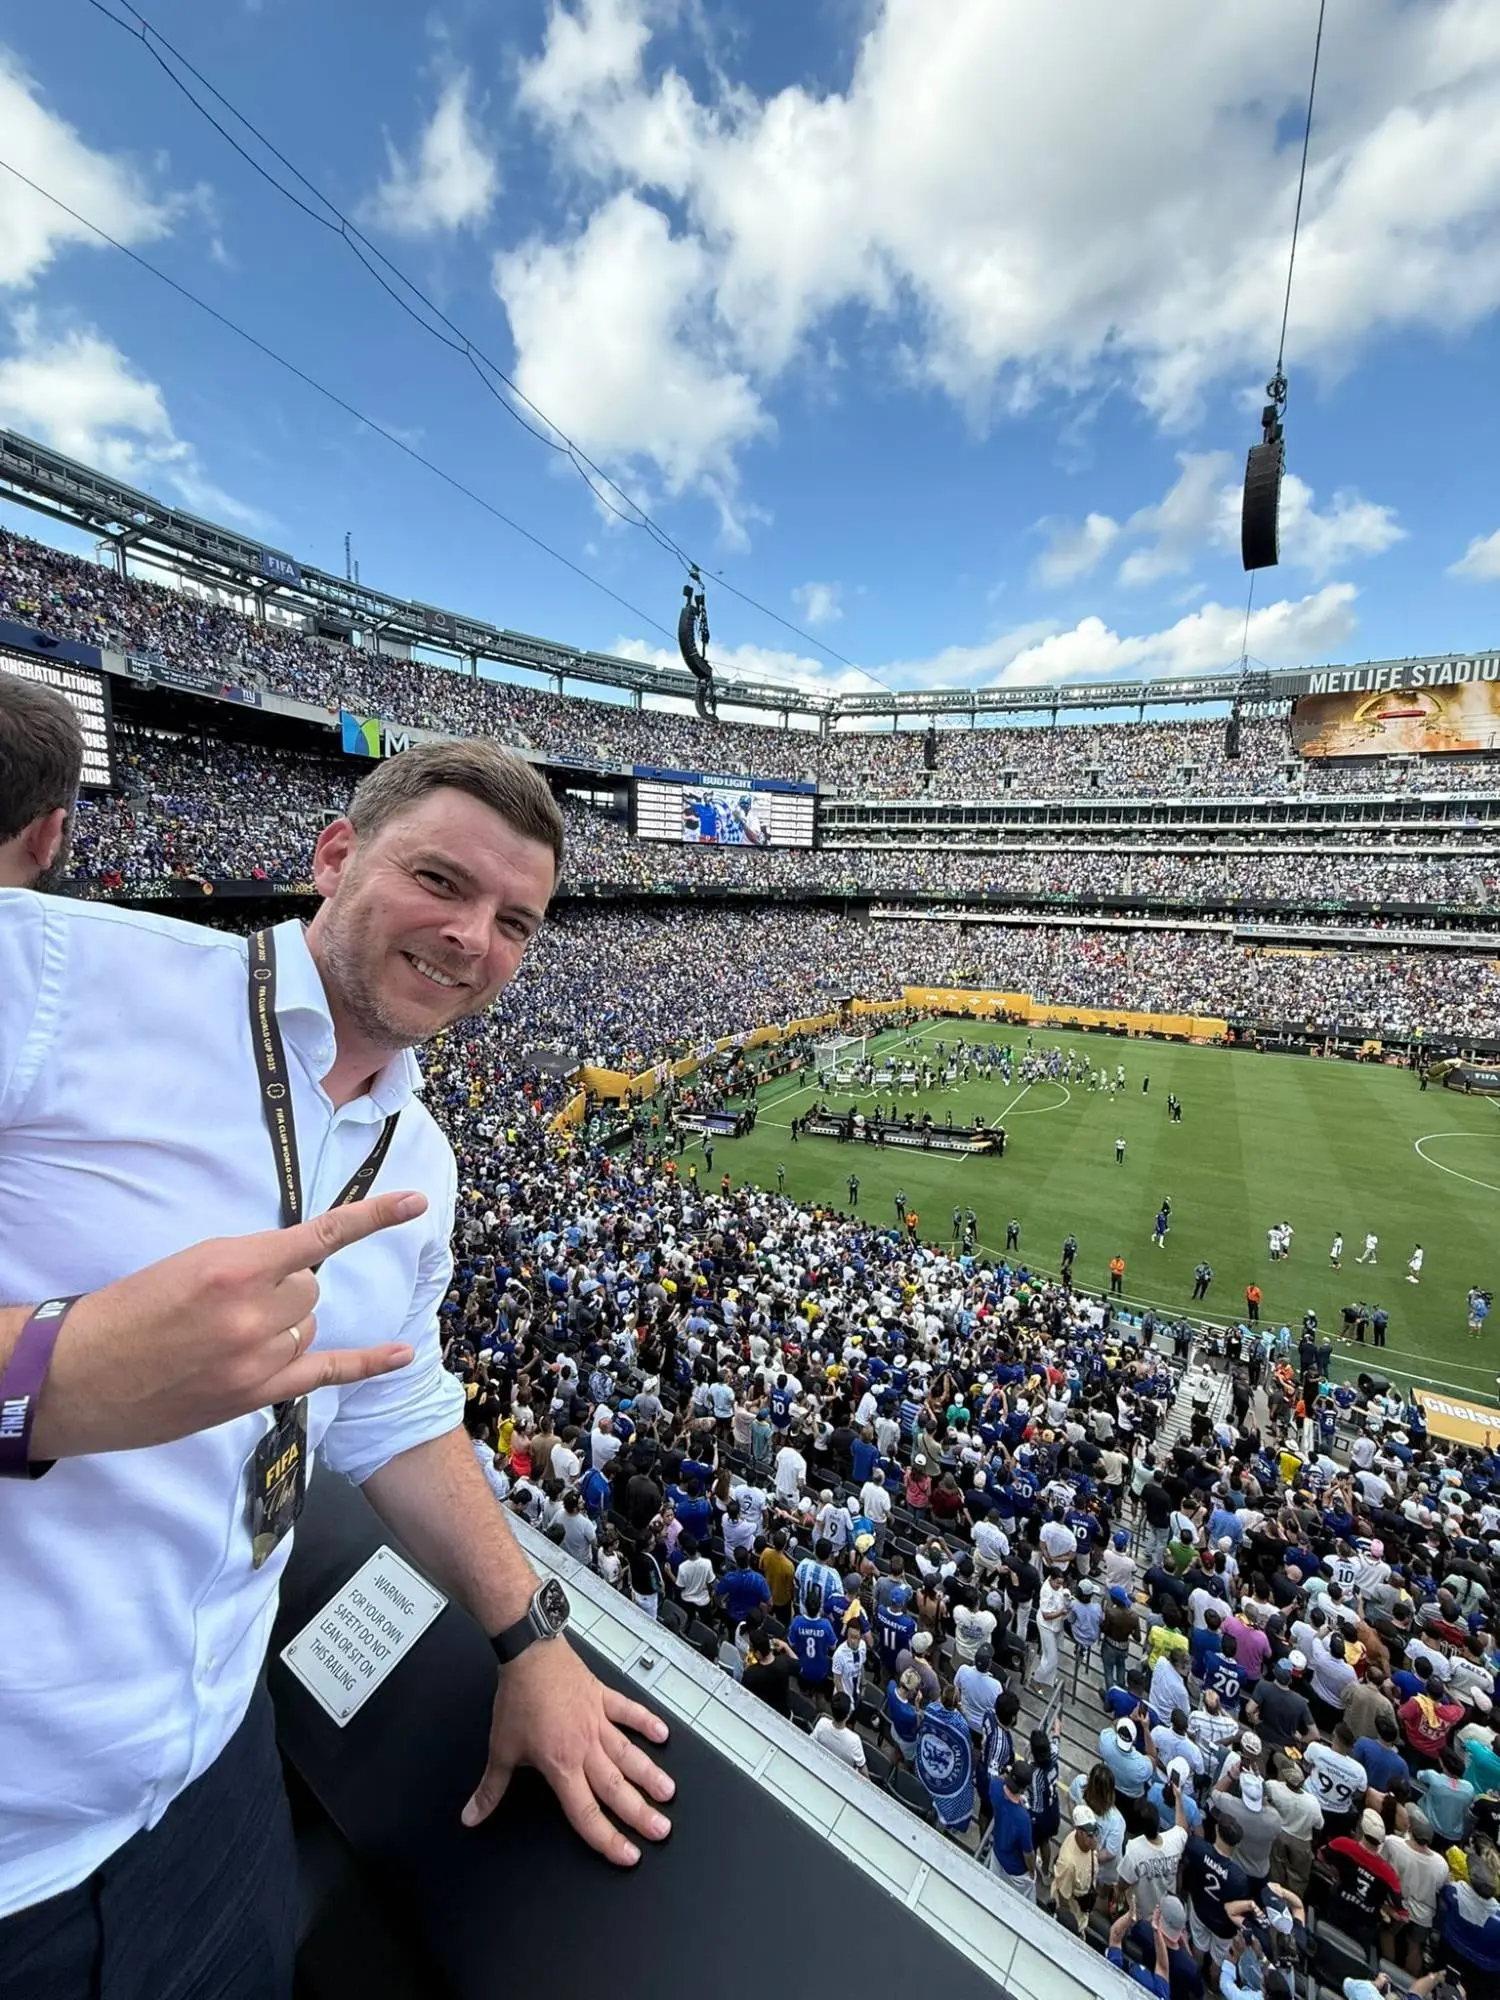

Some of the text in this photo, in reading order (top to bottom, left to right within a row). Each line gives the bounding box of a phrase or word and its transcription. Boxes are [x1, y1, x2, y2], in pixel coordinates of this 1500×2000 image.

[268, 556, 296, 577] FIFA
[0, 655, 103, 696] ONGRATULATIONS
[1309, 658, 1500, 695] METLIFE STADIU
[702, 775, 752, 789] BUD LIGHT
[273, 883, 295, 894] FINAL
[1437, 905, 1462, 914] FINAL
[259, 997, 267, 1013] CLUB
[260, 1014, 271, 1038] WORLD
[264, 1039, 273, 1053] CUP
[266, 1054, 276, 1071] 2025
[1474, 1072, 1498, 1081] FIFA
[275, 1107, 297, 1210] FIFA CLUB WORLD CUP 2025
[34, 1301, 68, 1320] VIP
[0, 1395, 30, 1438] FINAL
[772, 1400, 785, 1415] 10
[1423, 1396, 1500, 1430] Chelse
[1325, 1418, 1334, 1426] 8
[265, 1441, 299, 1490] FIFA
[830, 1522, 838, 1538] 9
[1072, 1524, 1088, 1539] 10
[1338, 1568, 1354, 1583] 10
[348, 1589, 405, 1645] FOR YOUR OWN
[334, 1603, 391, 1660] SAFETY DO NOT
[798, 1626, 825, 1638] LAMPARD
[883, 1627, 896, 1651] 11
[319, 1618, 377, 1679] LEAN OR SIT ON
[806, 1637, 816, 1658] 8
[309, 1637, 357, 1691] THIS RAILING
[1212, 1672, 1240, 1698] 20
[1318, 1771, 1352, 1802] 99
[1204, 1872, 1221, 1902] 2
